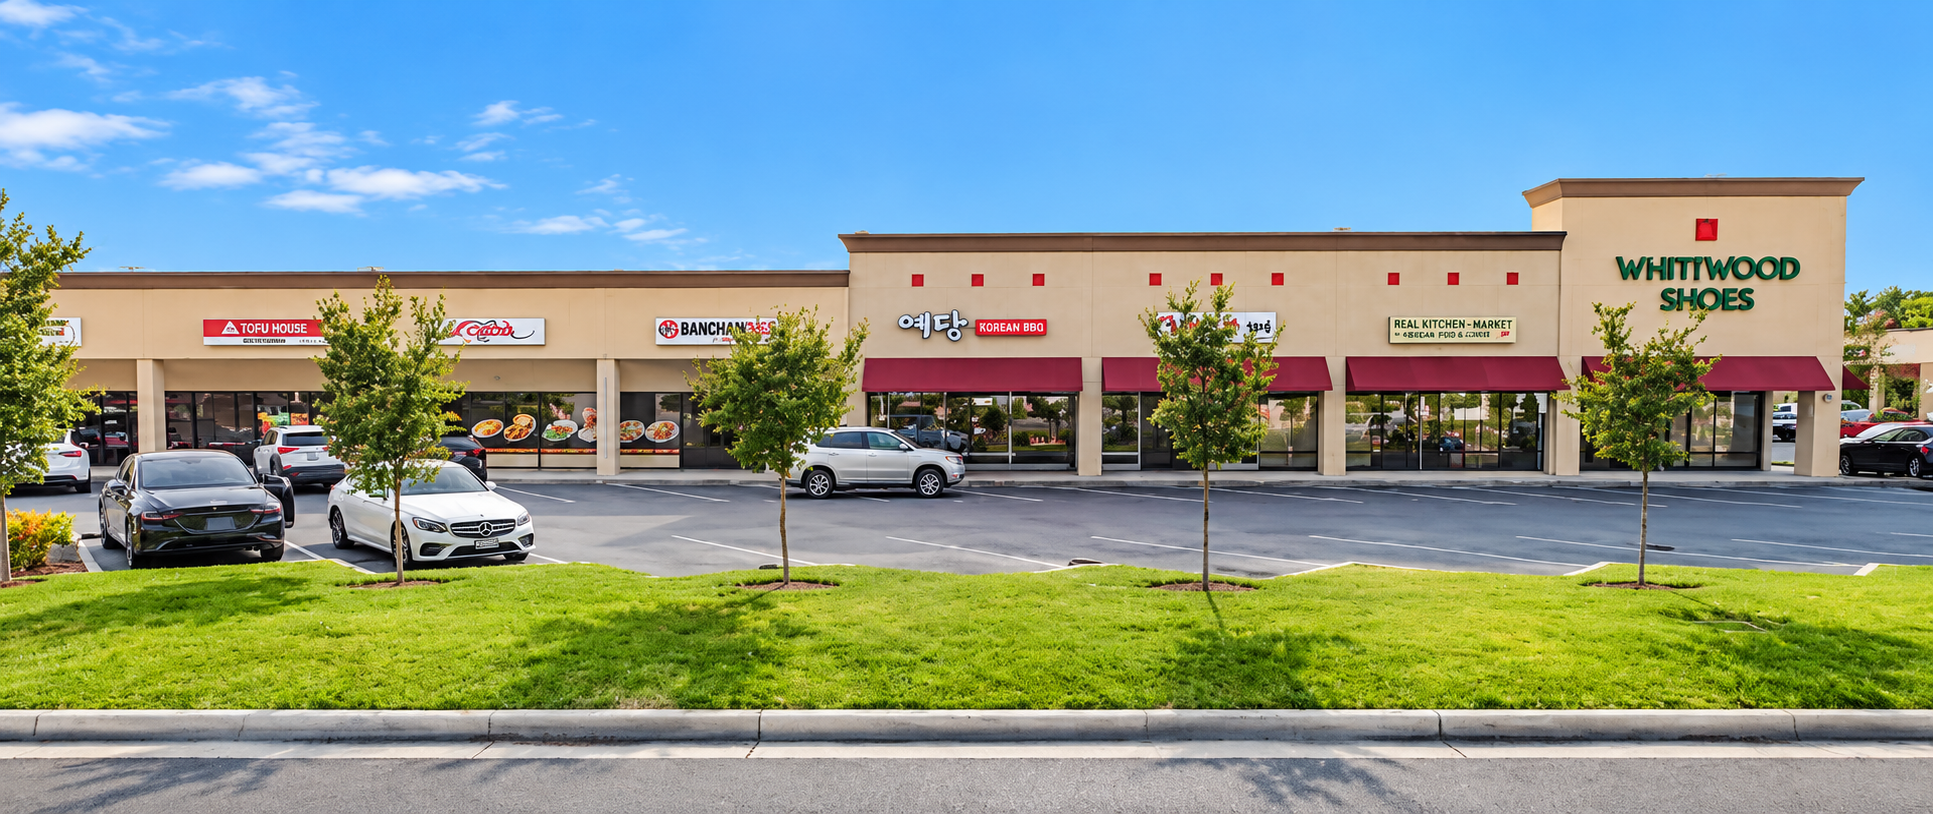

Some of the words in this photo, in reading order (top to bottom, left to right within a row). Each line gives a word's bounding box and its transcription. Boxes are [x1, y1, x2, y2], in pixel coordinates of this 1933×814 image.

[1660, 287, 1755, 312] SHOES
[240, 323, 269, 334] TOFU
[272, 323, 308, 334] HOUSE
[897, 309, 969, 342] 예당
[979, 322, 1020, 333] KOREAN
[1394, 319, 1420, 329] REAL
